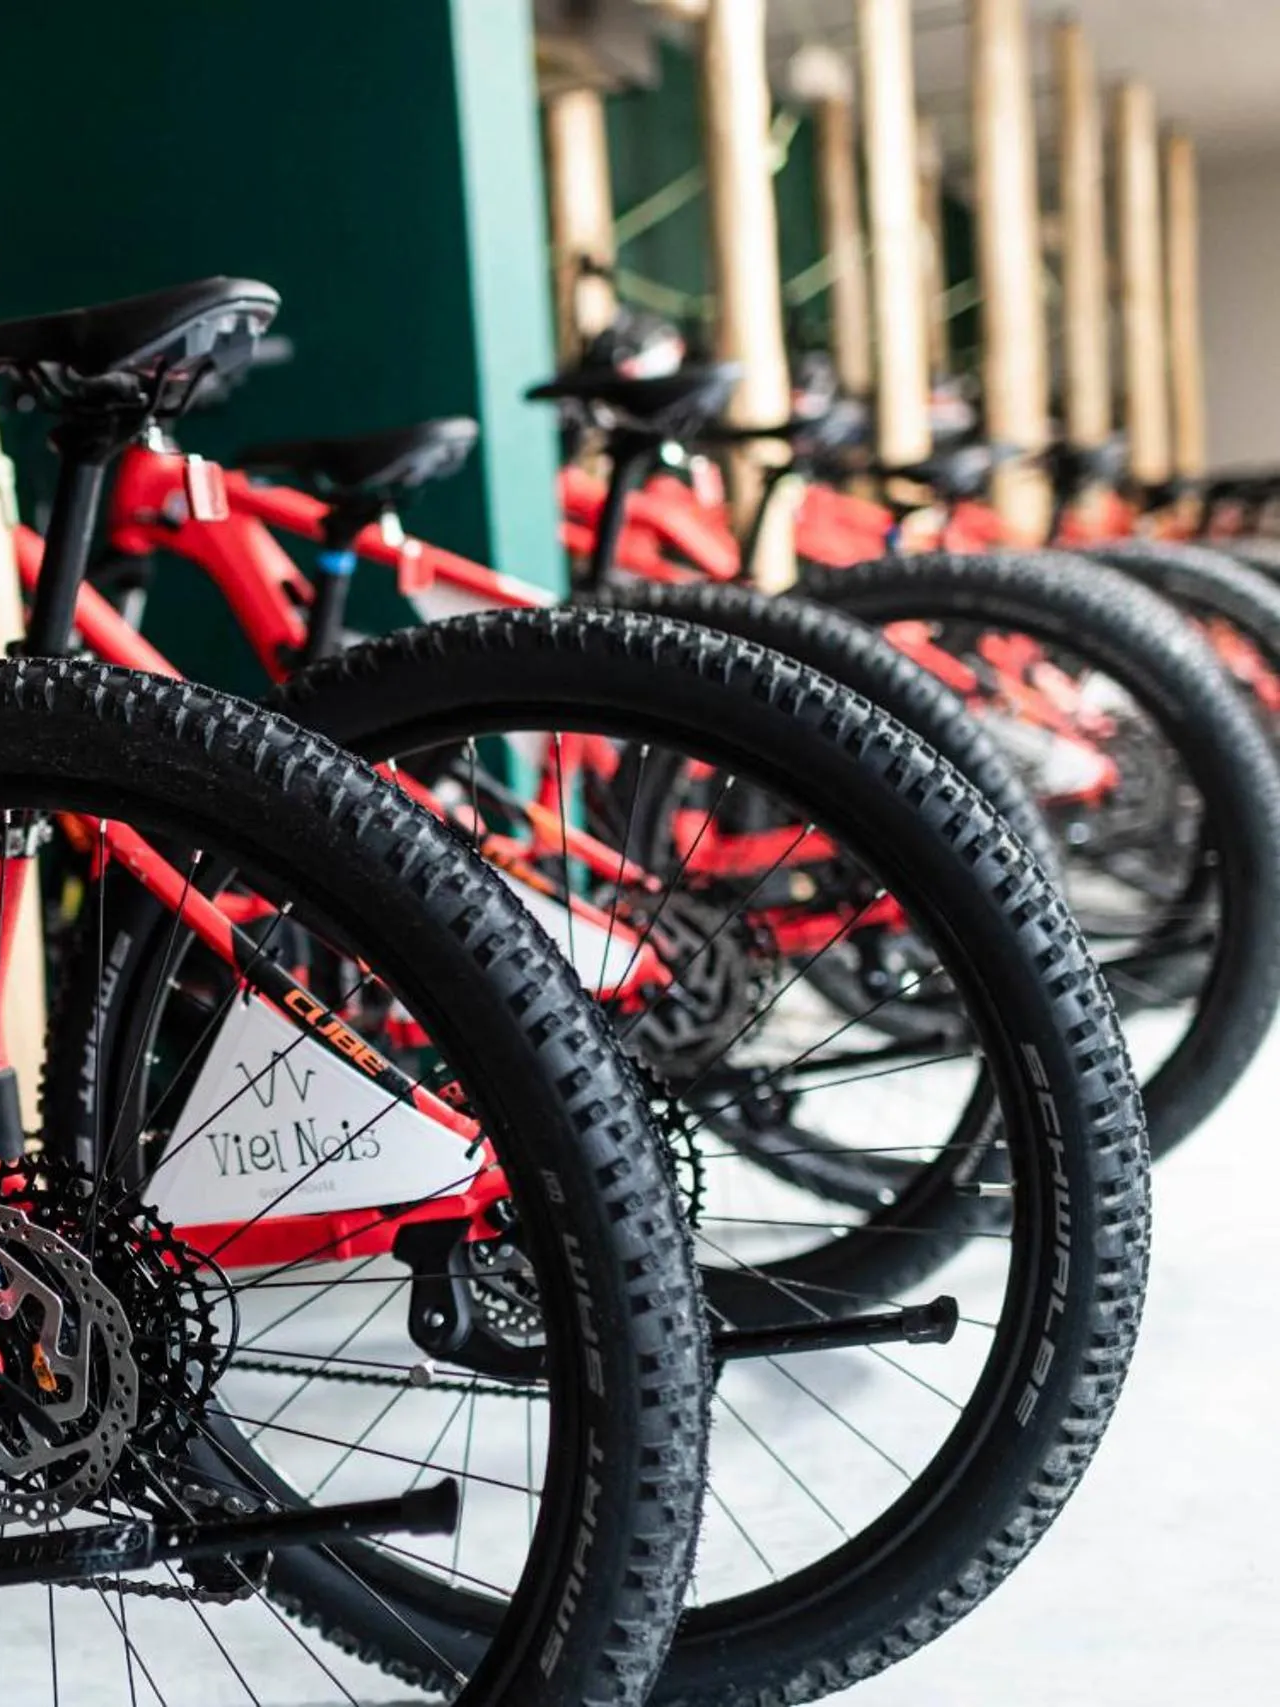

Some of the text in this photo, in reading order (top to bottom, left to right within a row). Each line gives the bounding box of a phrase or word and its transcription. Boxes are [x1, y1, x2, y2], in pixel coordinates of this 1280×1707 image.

[284, 988, 390, 1077] CUBE
[206, 1130, 288, 1176] Viel
[1015, 1041, 1071, 1427] SCHWALBE
[539, 1233, 605, 1680] SMART SAM
